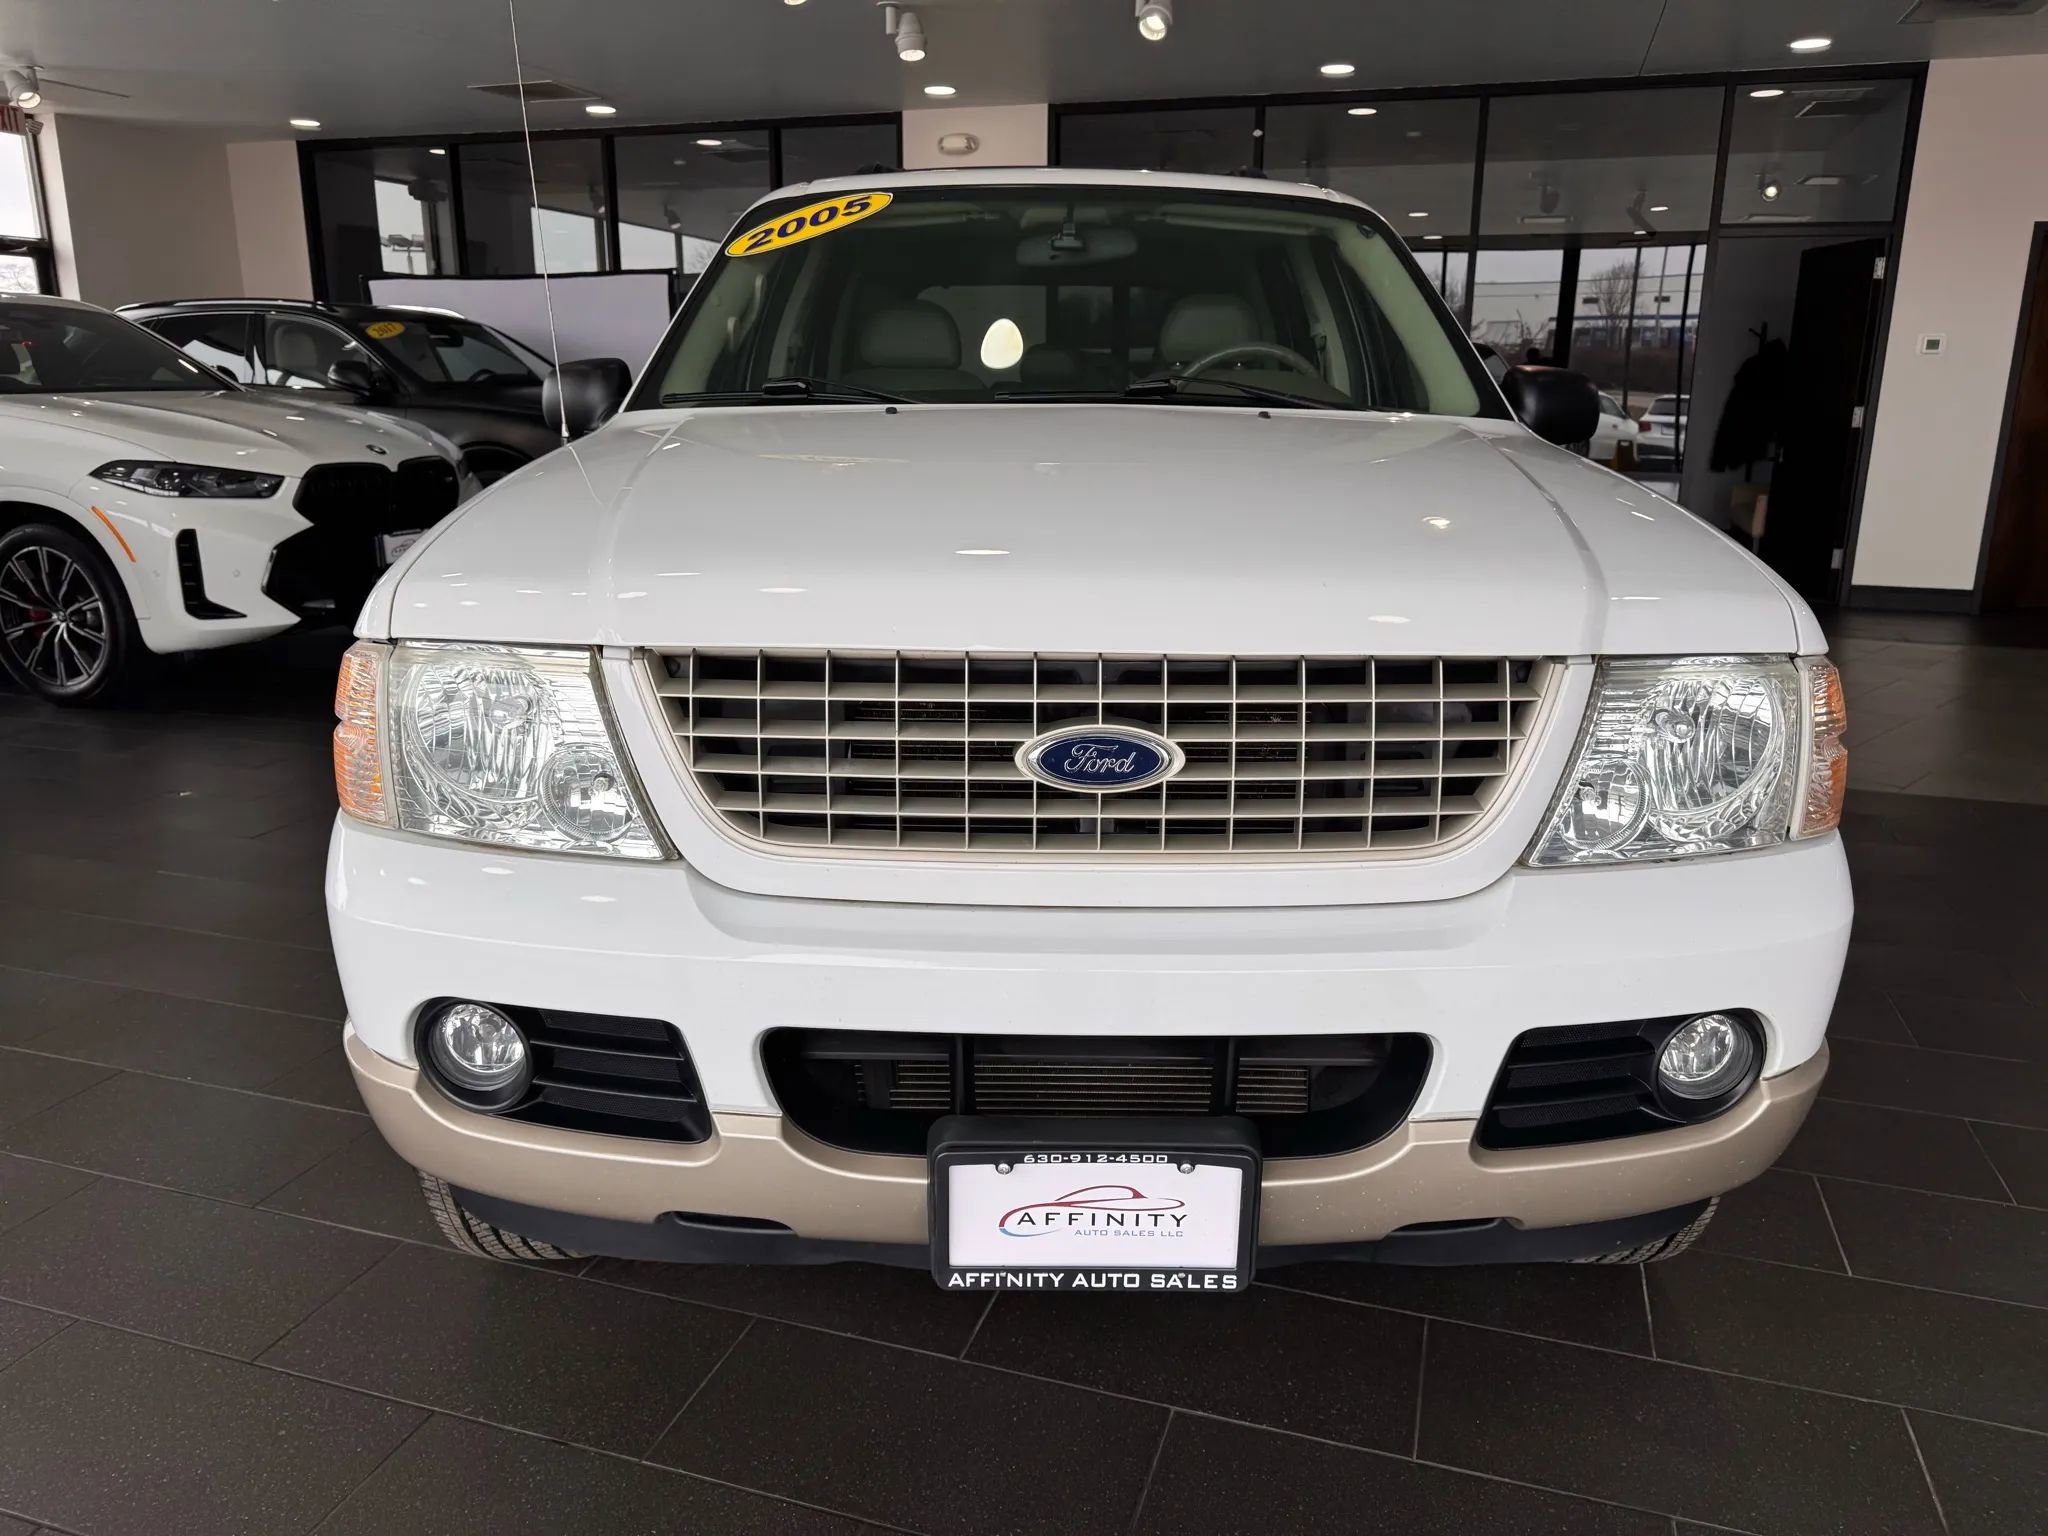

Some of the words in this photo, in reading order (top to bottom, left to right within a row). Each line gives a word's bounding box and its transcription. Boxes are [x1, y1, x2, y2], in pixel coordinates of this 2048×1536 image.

[0, 105, 20, 132] XIT
[743, 195, 872, 253] 2005
[1063, 743, 1137, 773] Ford
[1023, 1154, 1169, 1163] 630-912-4500
[1017, 1212, 1188, 1227] AFFINITY
[947, 1272, 1065, 1288] AFFINITY
[1071, 1273, 1140, 1289] AUTO
[1150, 1273, 1238, 1290] SALES
